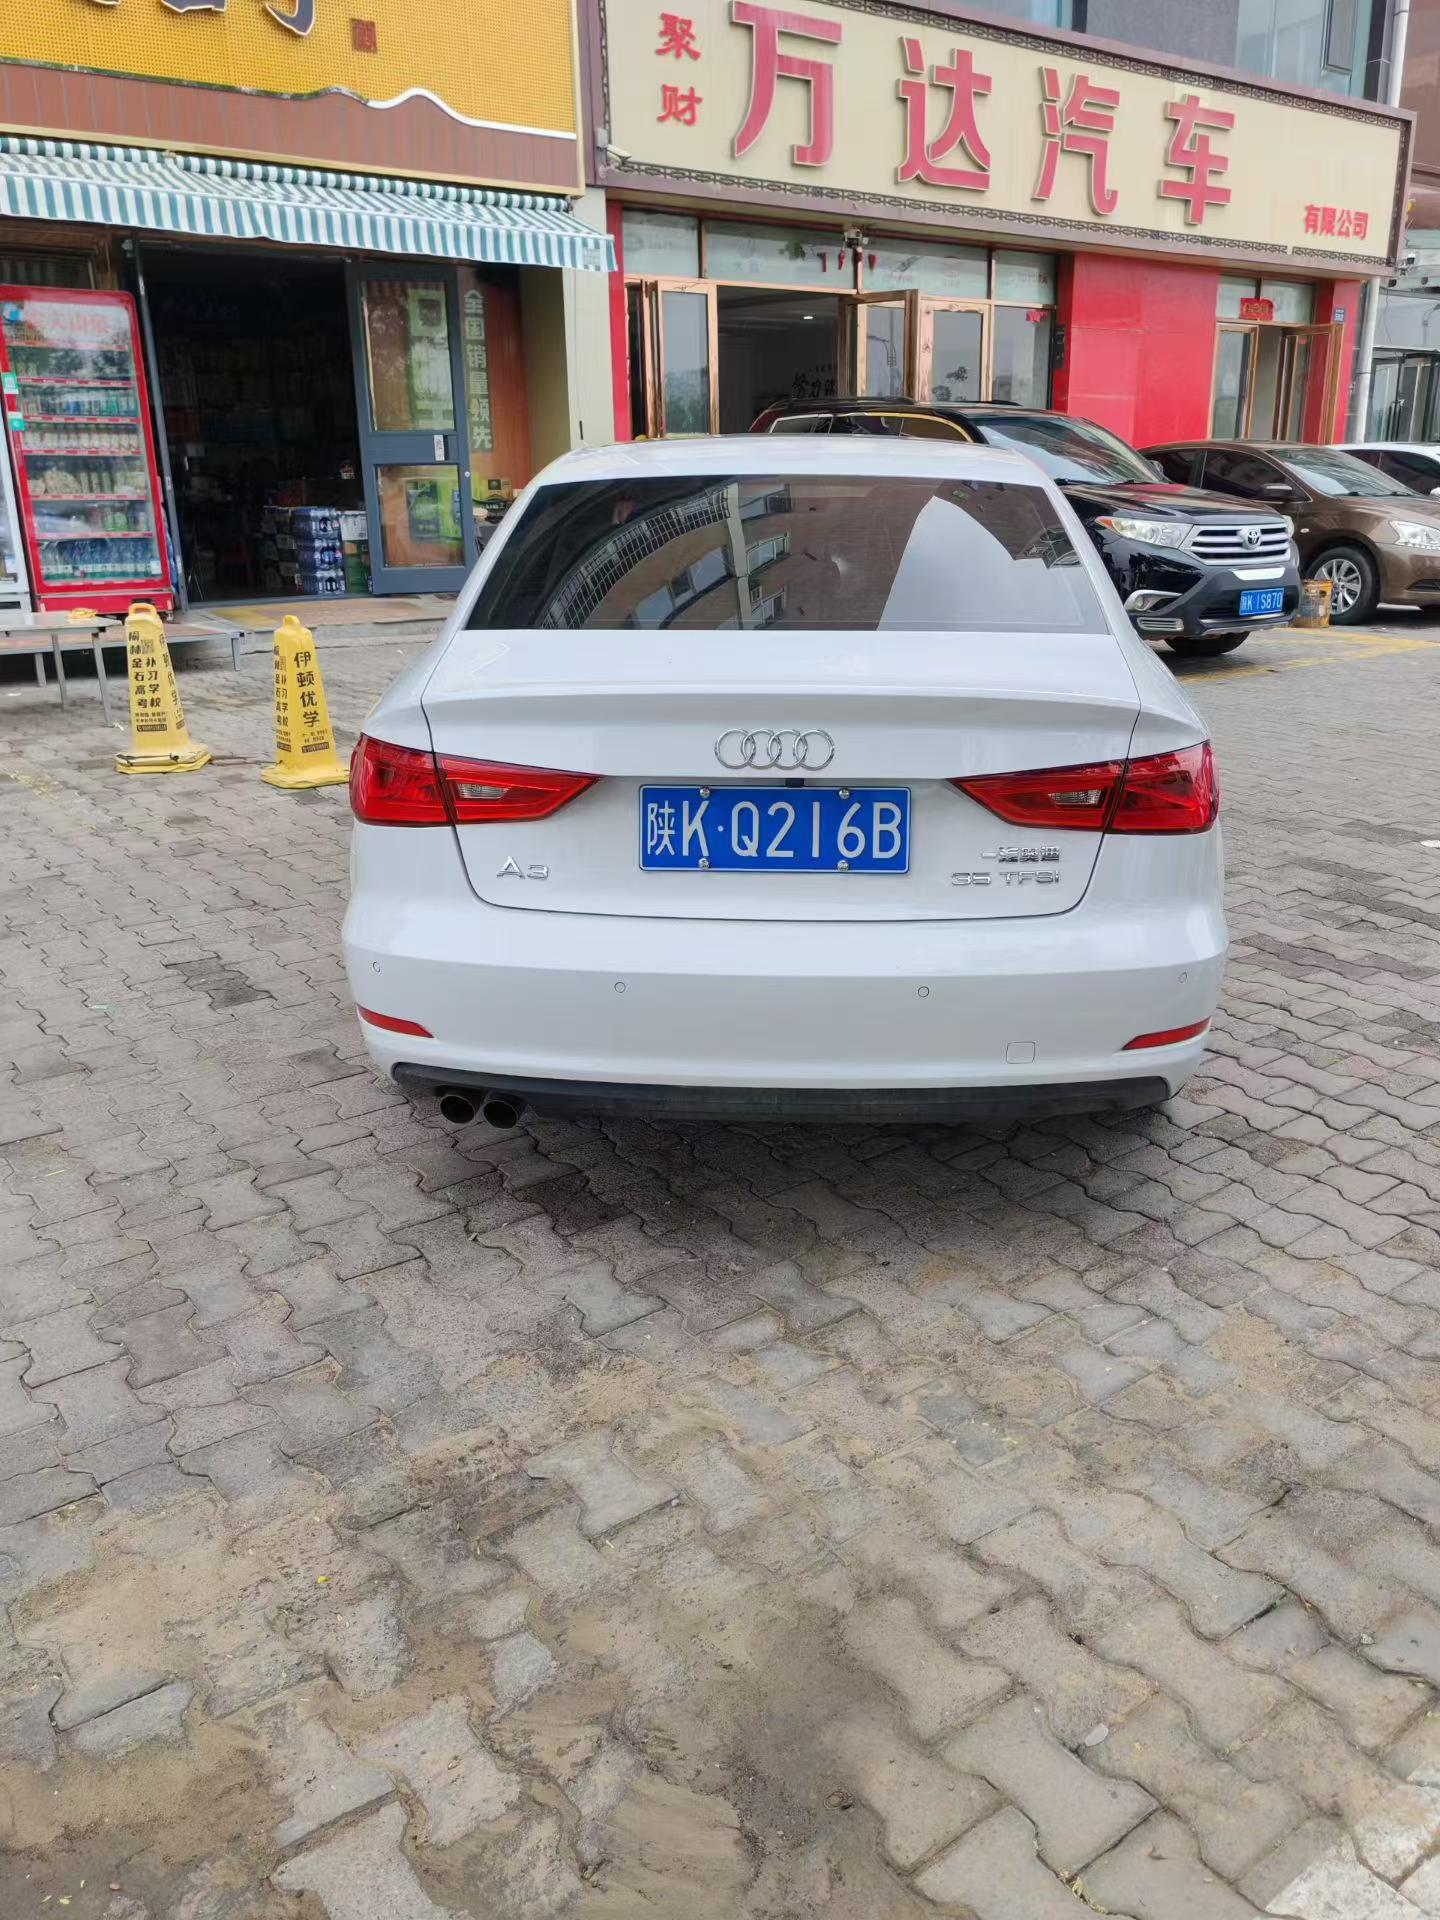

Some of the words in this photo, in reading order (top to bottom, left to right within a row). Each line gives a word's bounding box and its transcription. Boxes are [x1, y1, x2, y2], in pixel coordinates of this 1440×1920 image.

[654, 12, 702, 127] 聚财
[729, 1, 1236, 225] 万达汽车
[1303, 204, 1369, 241] 有限公司
[464, 289, 492, 449] 全国销量领先
[294, 651, 320, 727] 伊顿优学
[646, 801, 903, 861] 陕K·Q216B
[497, 856, 550, 880] A3
[952, 872, 991, 886] 35
